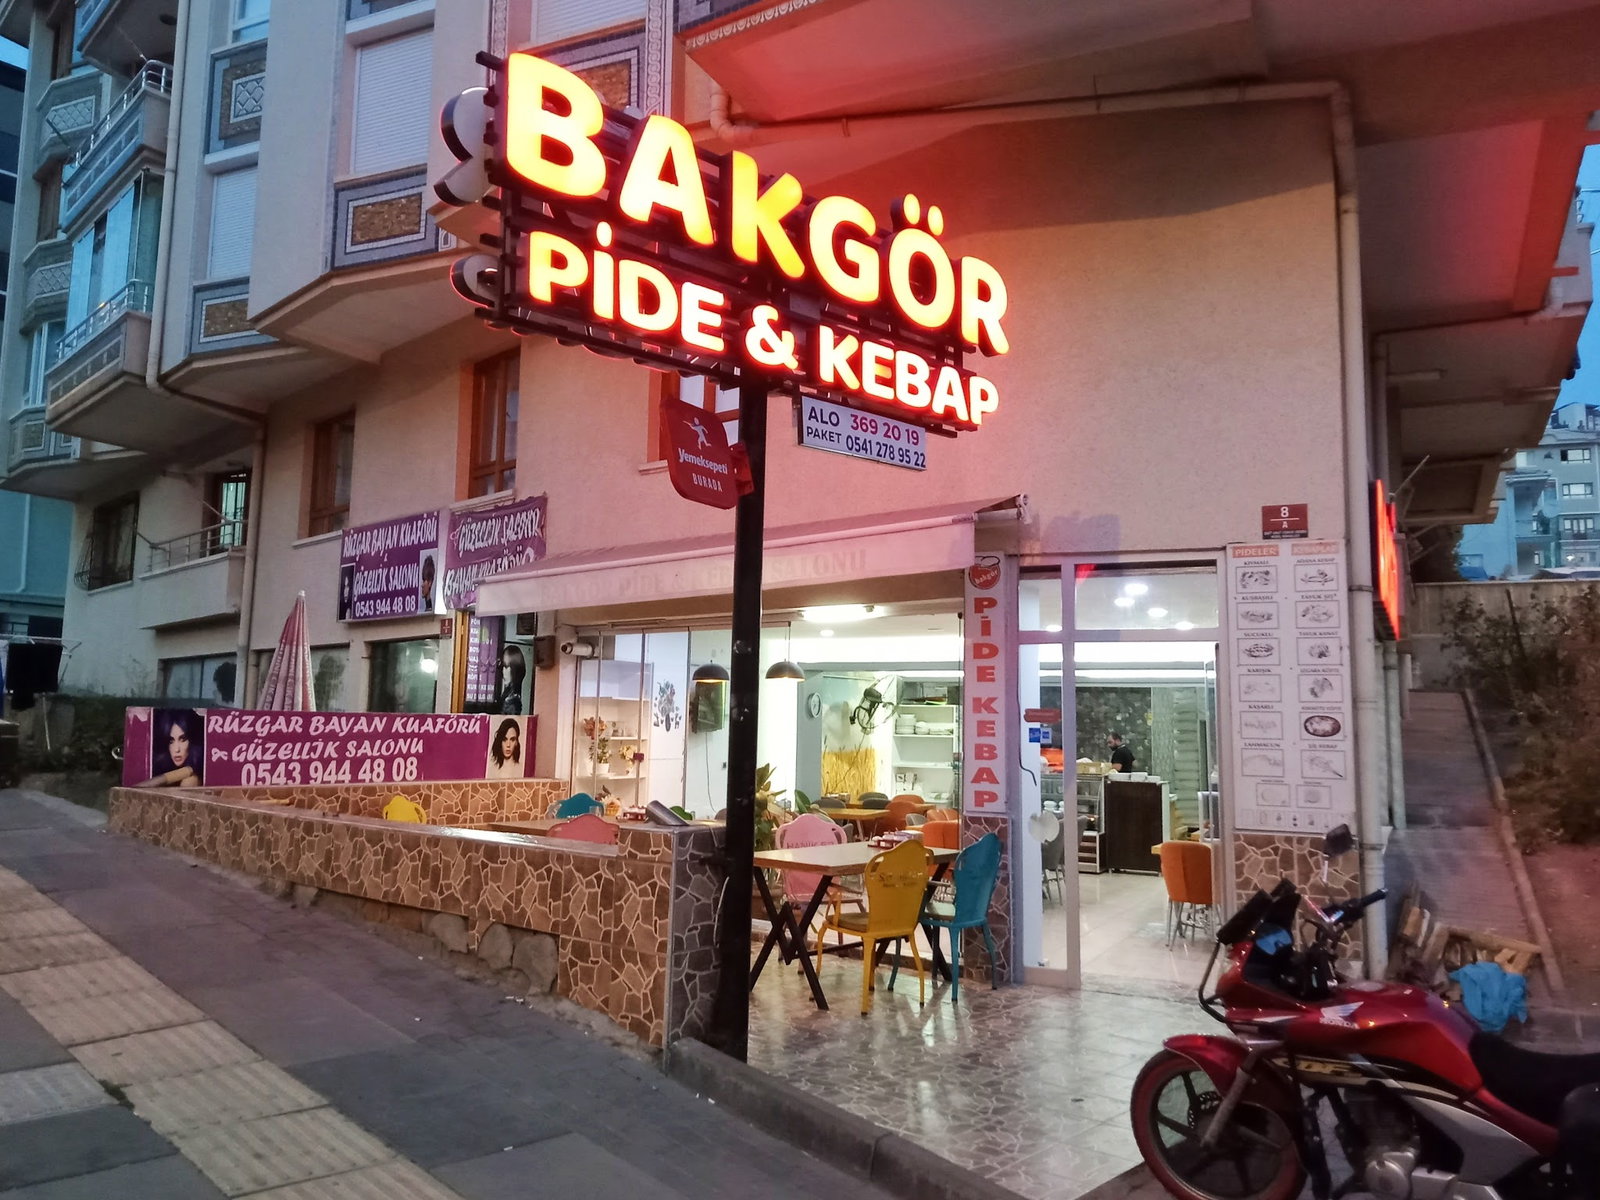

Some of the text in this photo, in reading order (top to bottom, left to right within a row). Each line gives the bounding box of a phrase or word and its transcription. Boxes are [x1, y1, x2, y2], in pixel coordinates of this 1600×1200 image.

[506, 52, 1010, 355] BAKGÖR
[528, 220, 1000, 426] PİDE & KEBAP
[808, 406, 920, 446] ALO 369 20 19
[678, 447, 728, 475] Yemeksepeti
[806, 426, 926, 468] PAKET 0541 278 95 22
[692, 473, 723, 492] BURADA
[1280, 506, 1289, 518] 8
[1282, 521, 1288, 529] A
[343, 511, 438, 562] RÜZGAR BAYAN KUAFÖRÜ
[772, 549, 867, 578] SALONU
[353, 562, 419, 602] GÜZELLİK SALONU
[355, 595, 416, 618] 0543 944 48 08
[207, 711, 481, 737] RÜZGAR BAYAN KUAFÖRÜ
[231, 738, 341, 763] GÜZELLİK
[345, 737, 424, 758] SALONU
[970, 696, 1000, 808] KEBAP
[241, 756, 418, 786] 0543 944 48 08
